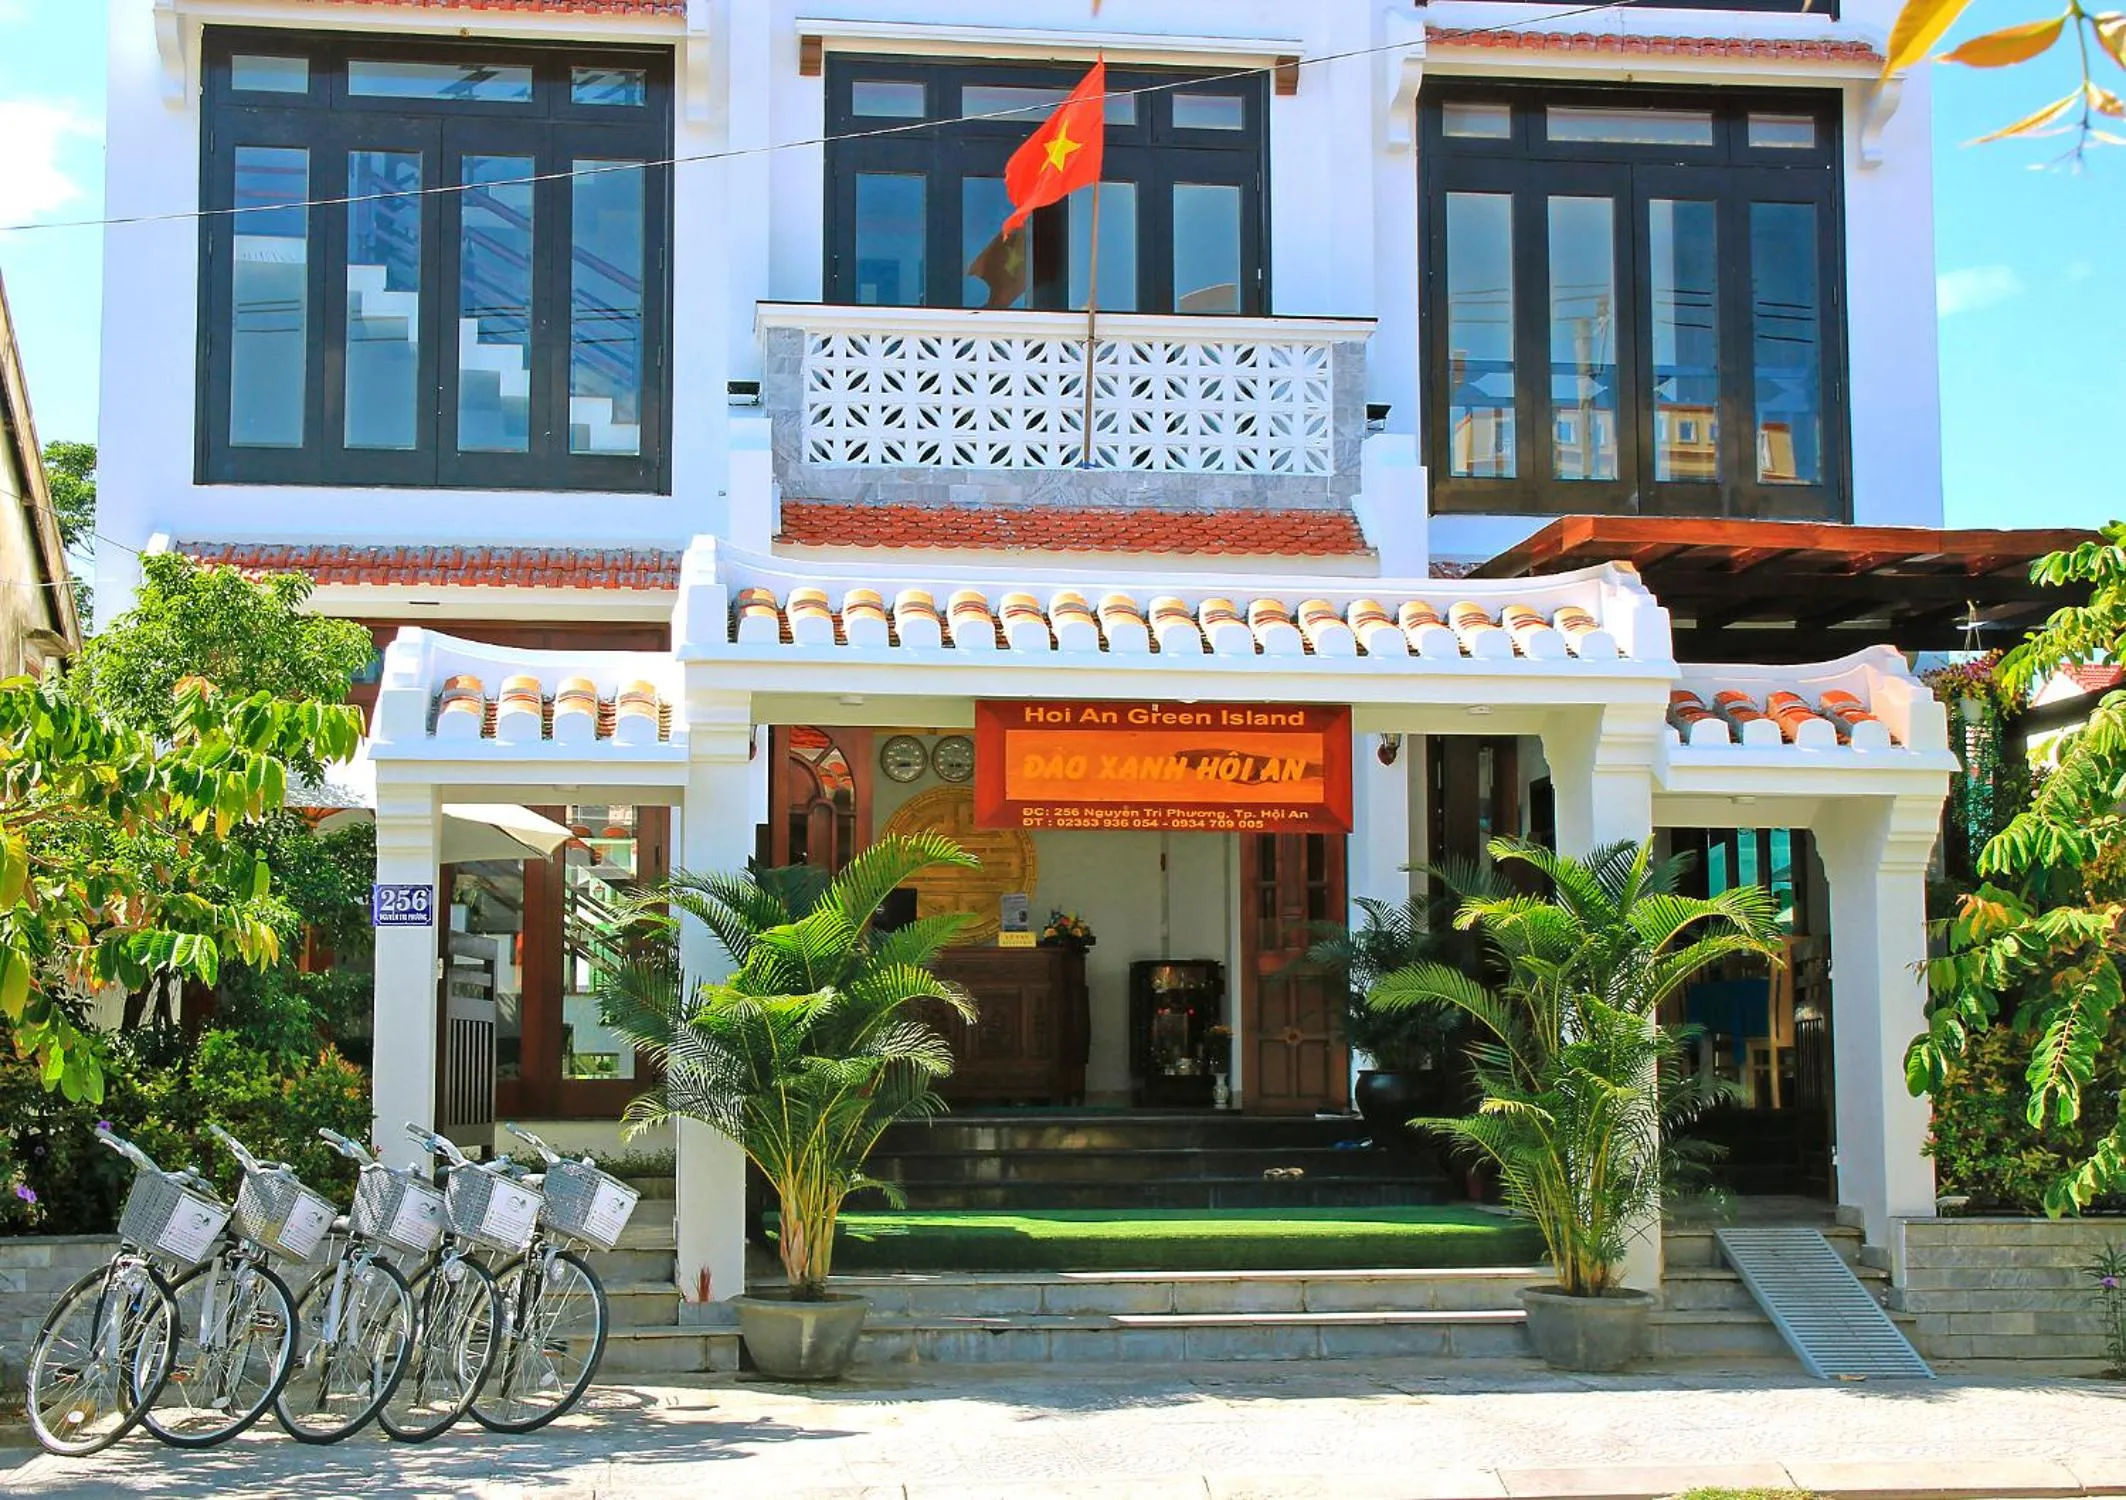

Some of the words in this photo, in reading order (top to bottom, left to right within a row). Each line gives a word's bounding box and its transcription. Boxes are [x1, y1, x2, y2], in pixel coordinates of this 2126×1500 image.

[1024, 706, 1071, 723] Hoi
[1079, 708, 1118, 724] An
[1127, 707, 1211, 725] Green
[1221, 709, 1304, 726] Island
[1100, 754, 1189, 780] XANH
[1259, 757, 1308, 782] AN
[1022, 807, 1050, 816] ĐC:
[1054, 807, 1080, 816] 256
[1143, 808, 1162, 817] Tri
[1234, 809, 1257, 819] Tp.
[1288, 810, 1309, 819] An
[1022, 817, 1043, 826] ĐT
[1056, 818, 1099, 827] 02353
[1132, 818, 1159, 828] 054
[1171, 819, 1205, 828] 0934
[1209, 819, 1235, 829] 709
[1238, 820, 1264, 829] 005
[380, 889, 427, 911] 256
